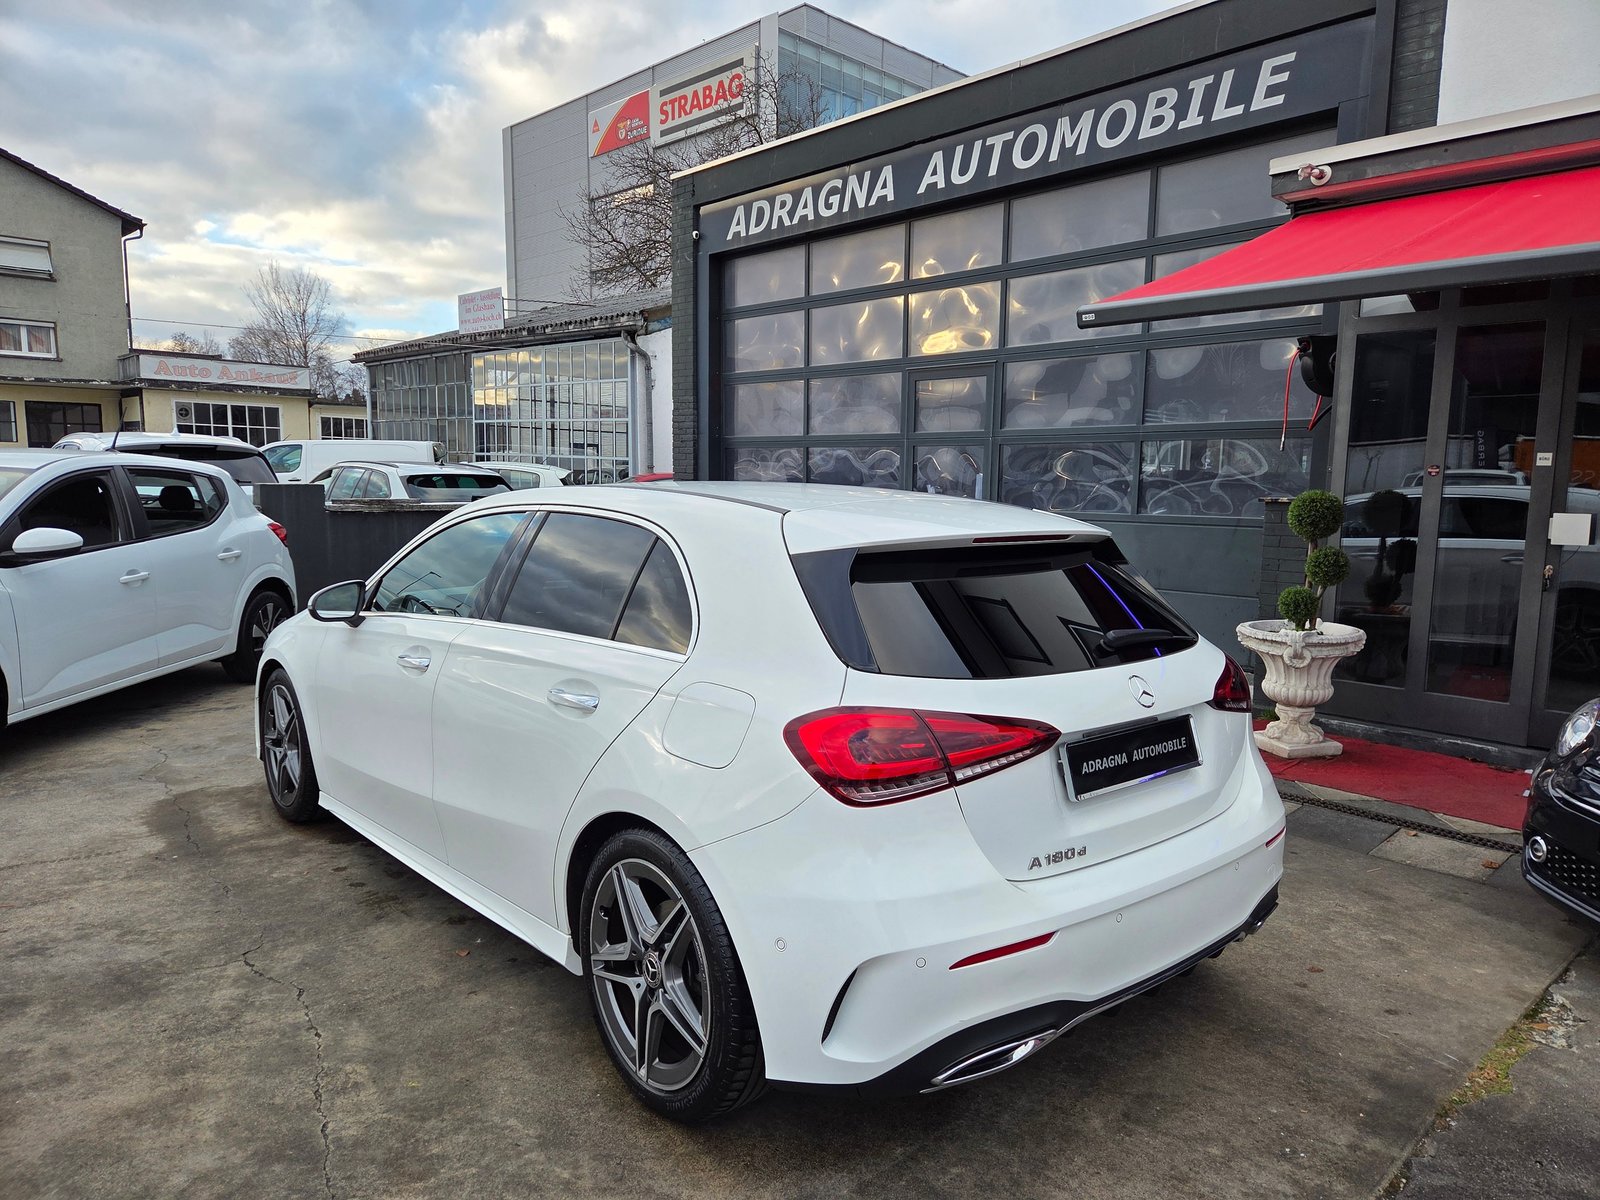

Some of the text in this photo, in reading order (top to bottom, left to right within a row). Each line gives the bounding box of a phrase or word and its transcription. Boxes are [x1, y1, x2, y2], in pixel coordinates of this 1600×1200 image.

[659, 73, 744, 125] STRABAG
[726, 51, 1298, 241] ADRAGNA AUTOMOBILE
[473, 302, 496, 313] Glashaus
[154, 359, 299, 386] Auto Ankauf
[1082, 736, 1187, 775] ADRAGNA AUTOMOBILE
